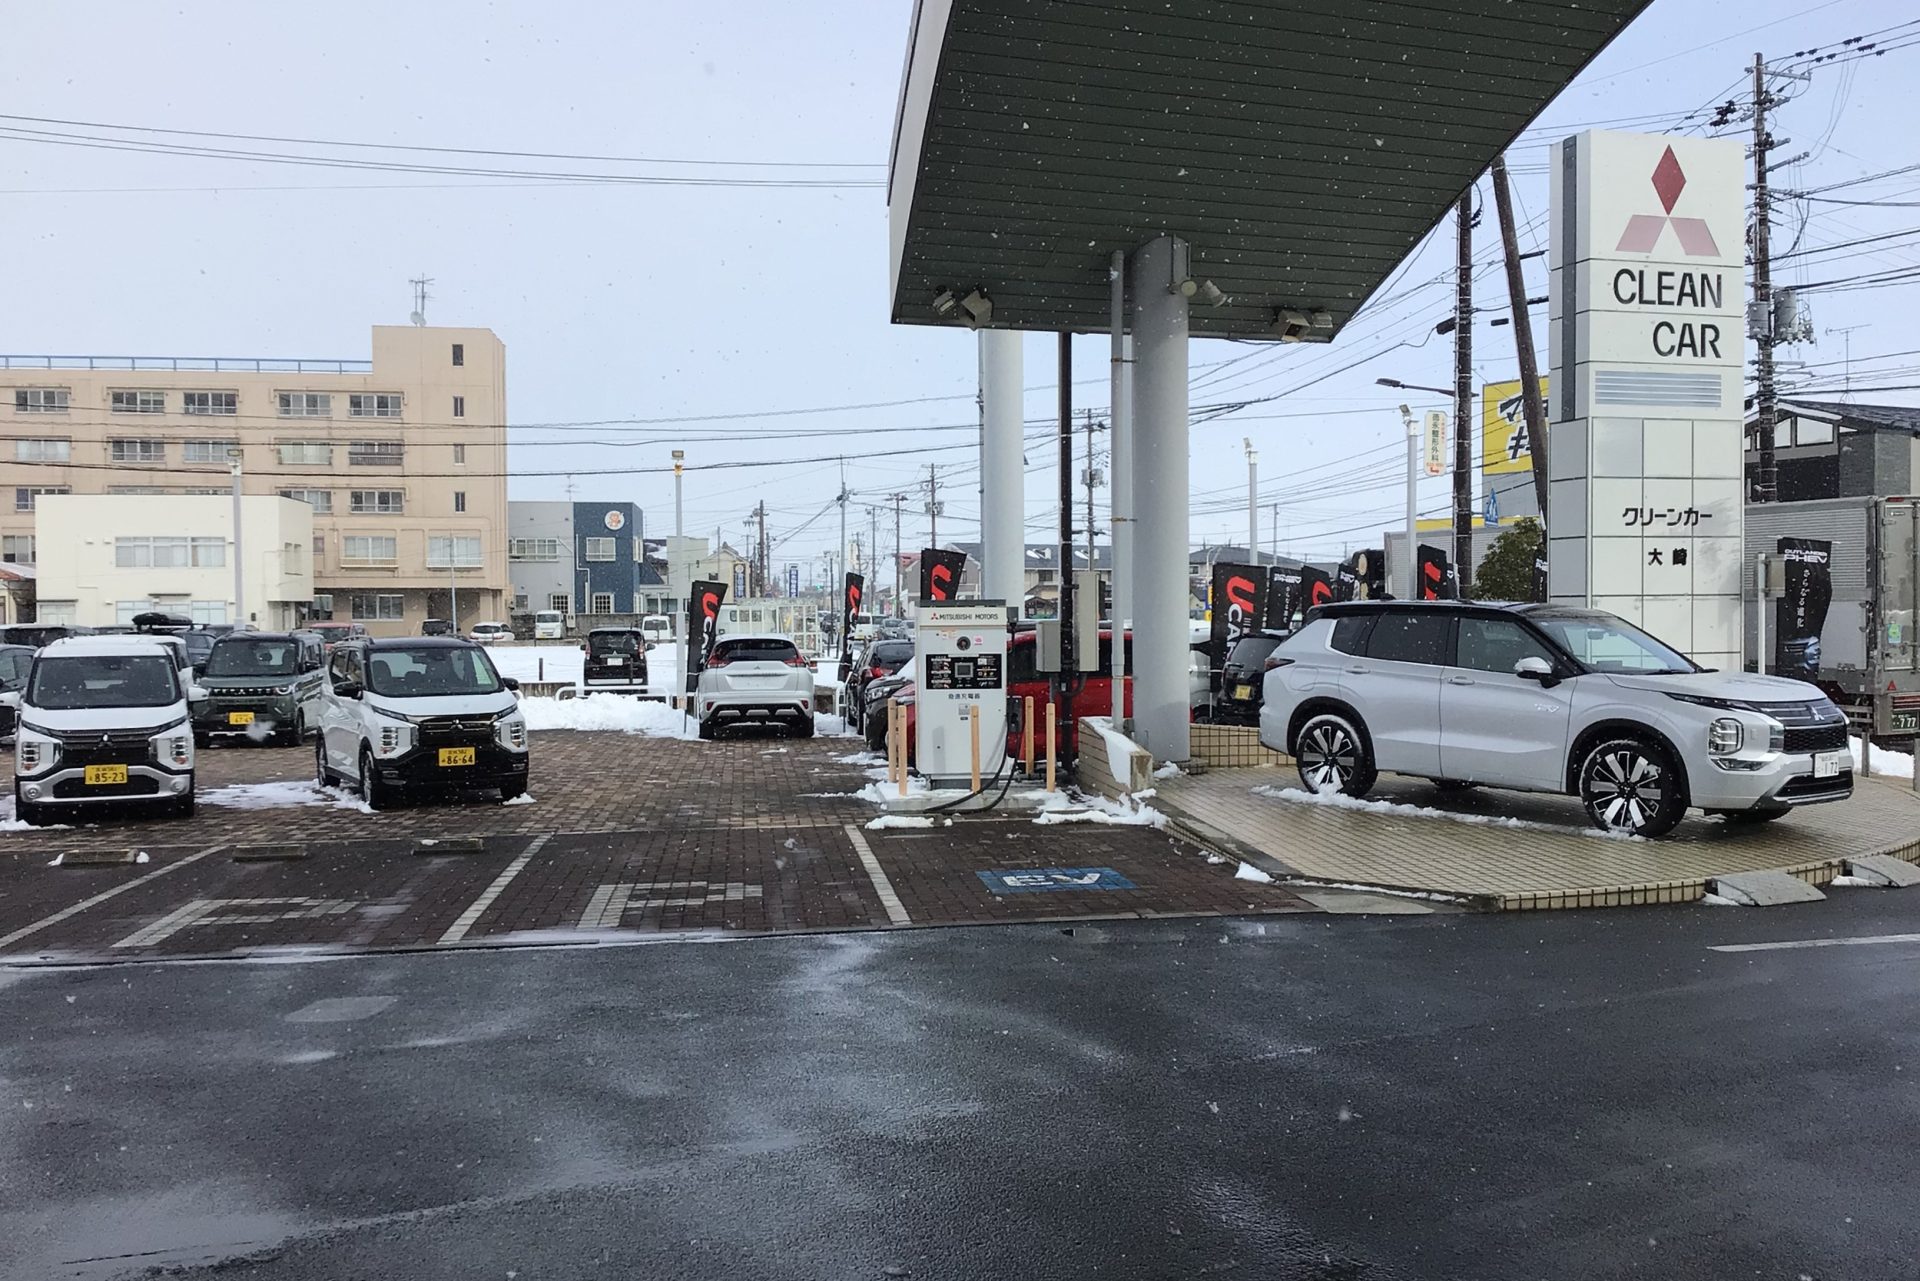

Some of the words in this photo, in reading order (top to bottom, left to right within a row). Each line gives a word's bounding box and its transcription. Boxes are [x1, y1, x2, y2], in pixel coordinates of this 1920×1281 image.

[1613, 267, 1722, 308] CLEAN
[1653, 320, 1722, 359] CAR
[1622, 507, 1713, 527] クリーンカー
[1783, 553, 1828, 564] PHEV
[95, 772, 125, 783] 85-23
[1002, 873, 1101, 887] EV
